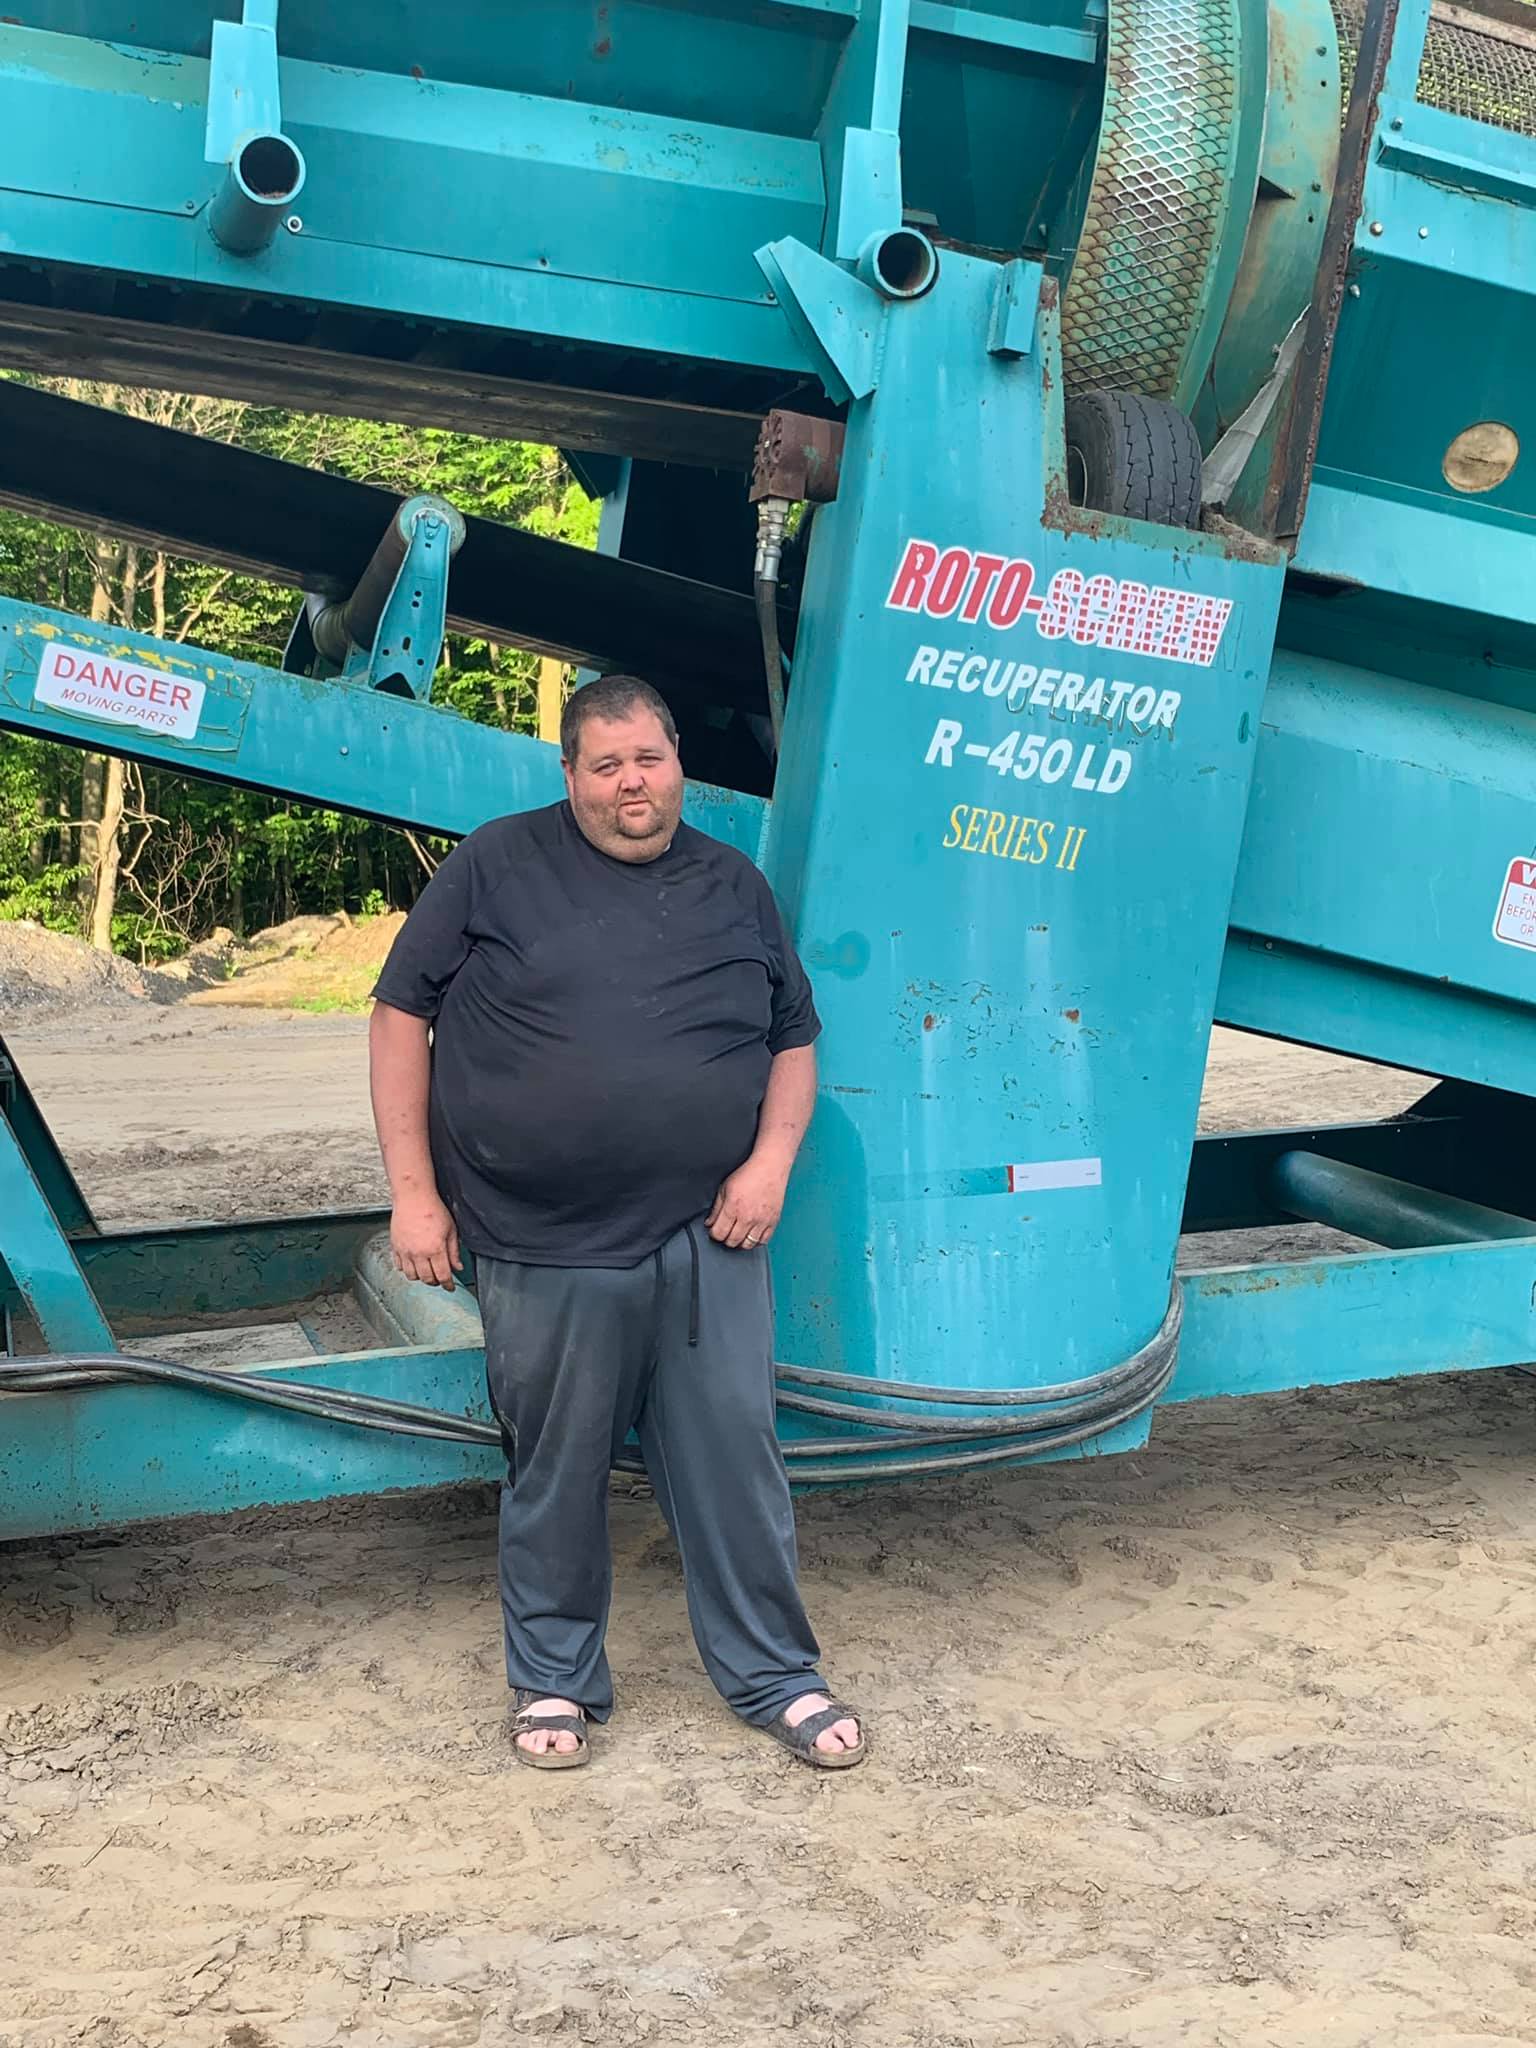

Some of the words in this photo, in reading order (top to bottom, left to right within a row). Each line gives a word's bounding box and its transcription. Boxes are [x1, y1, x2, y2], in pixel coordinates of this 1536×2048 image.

[885, 539, 1234, 667] ROTO-SCREEN
[53, 655, 192, 711] DANGER
[60, 689, 122, 712] MOVING
[126, 705, 178, 727] PARTS
[905, 645, 1182, 728] RECUPERATOR
[943, 804, 1056, 864] SERIES
[1056, 826, 1087, 871] II
